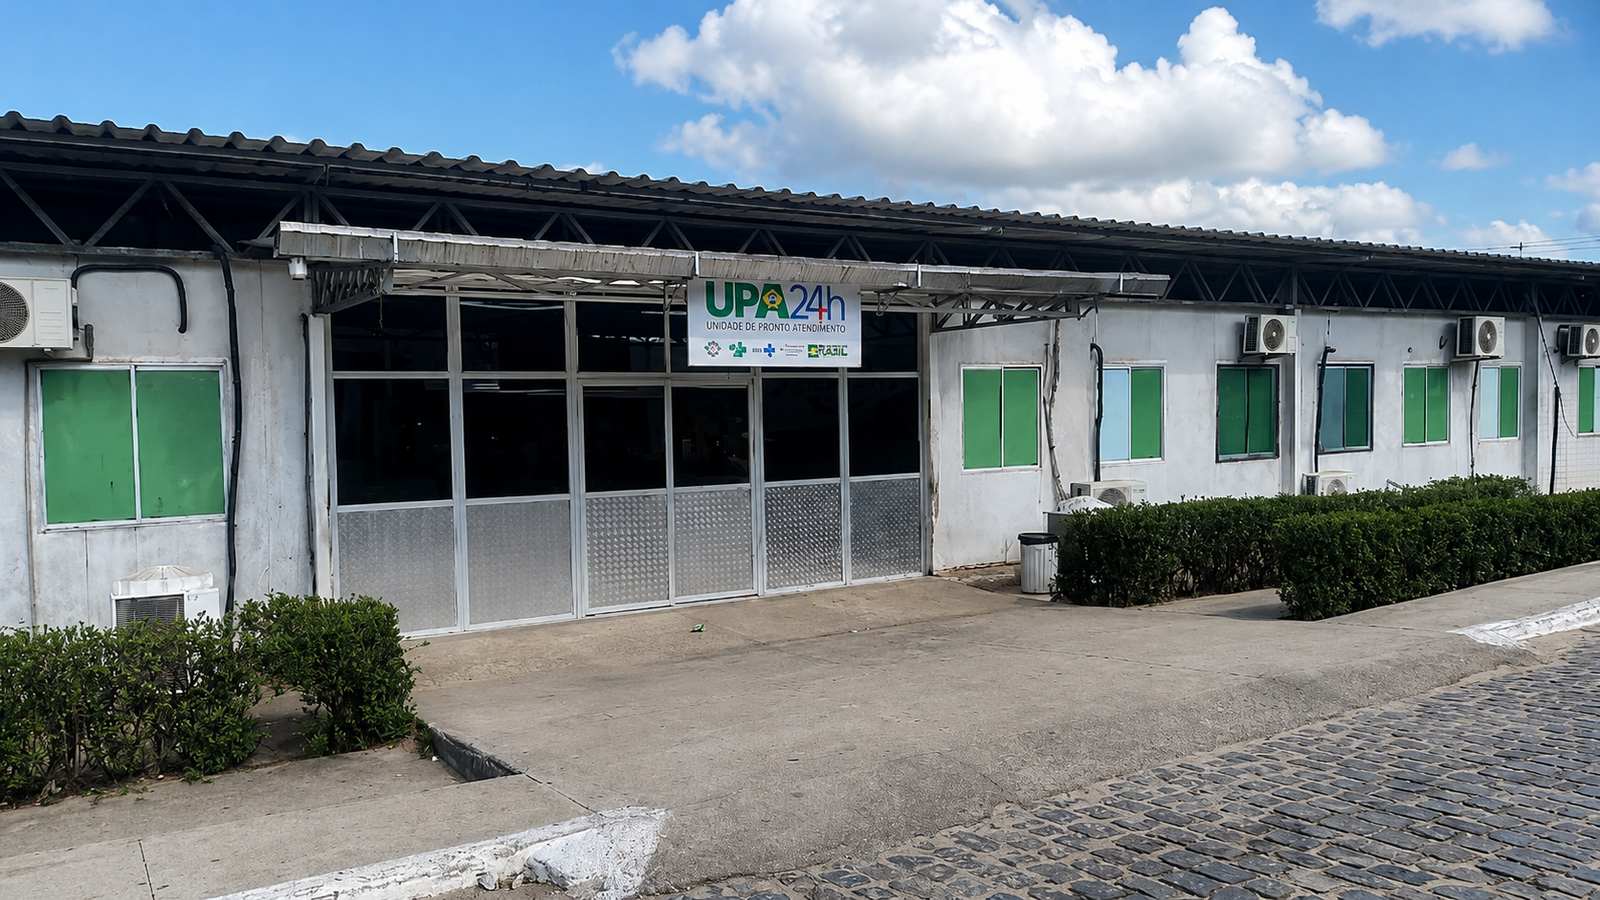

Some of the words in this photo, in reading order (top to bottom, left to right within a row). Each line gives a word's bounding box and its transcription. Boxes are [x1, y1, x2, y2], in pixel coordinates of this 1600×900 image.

[705, 280, 790, 319] UPA
[790, 284, 846, 322] 24h
[706, 321, 743, 331] UNIDADE
[745, 322, 756, 331] DE
[758, 323, 790, 332] PRONTO
[792, 323, 846, 333] ATENDIMENTO
